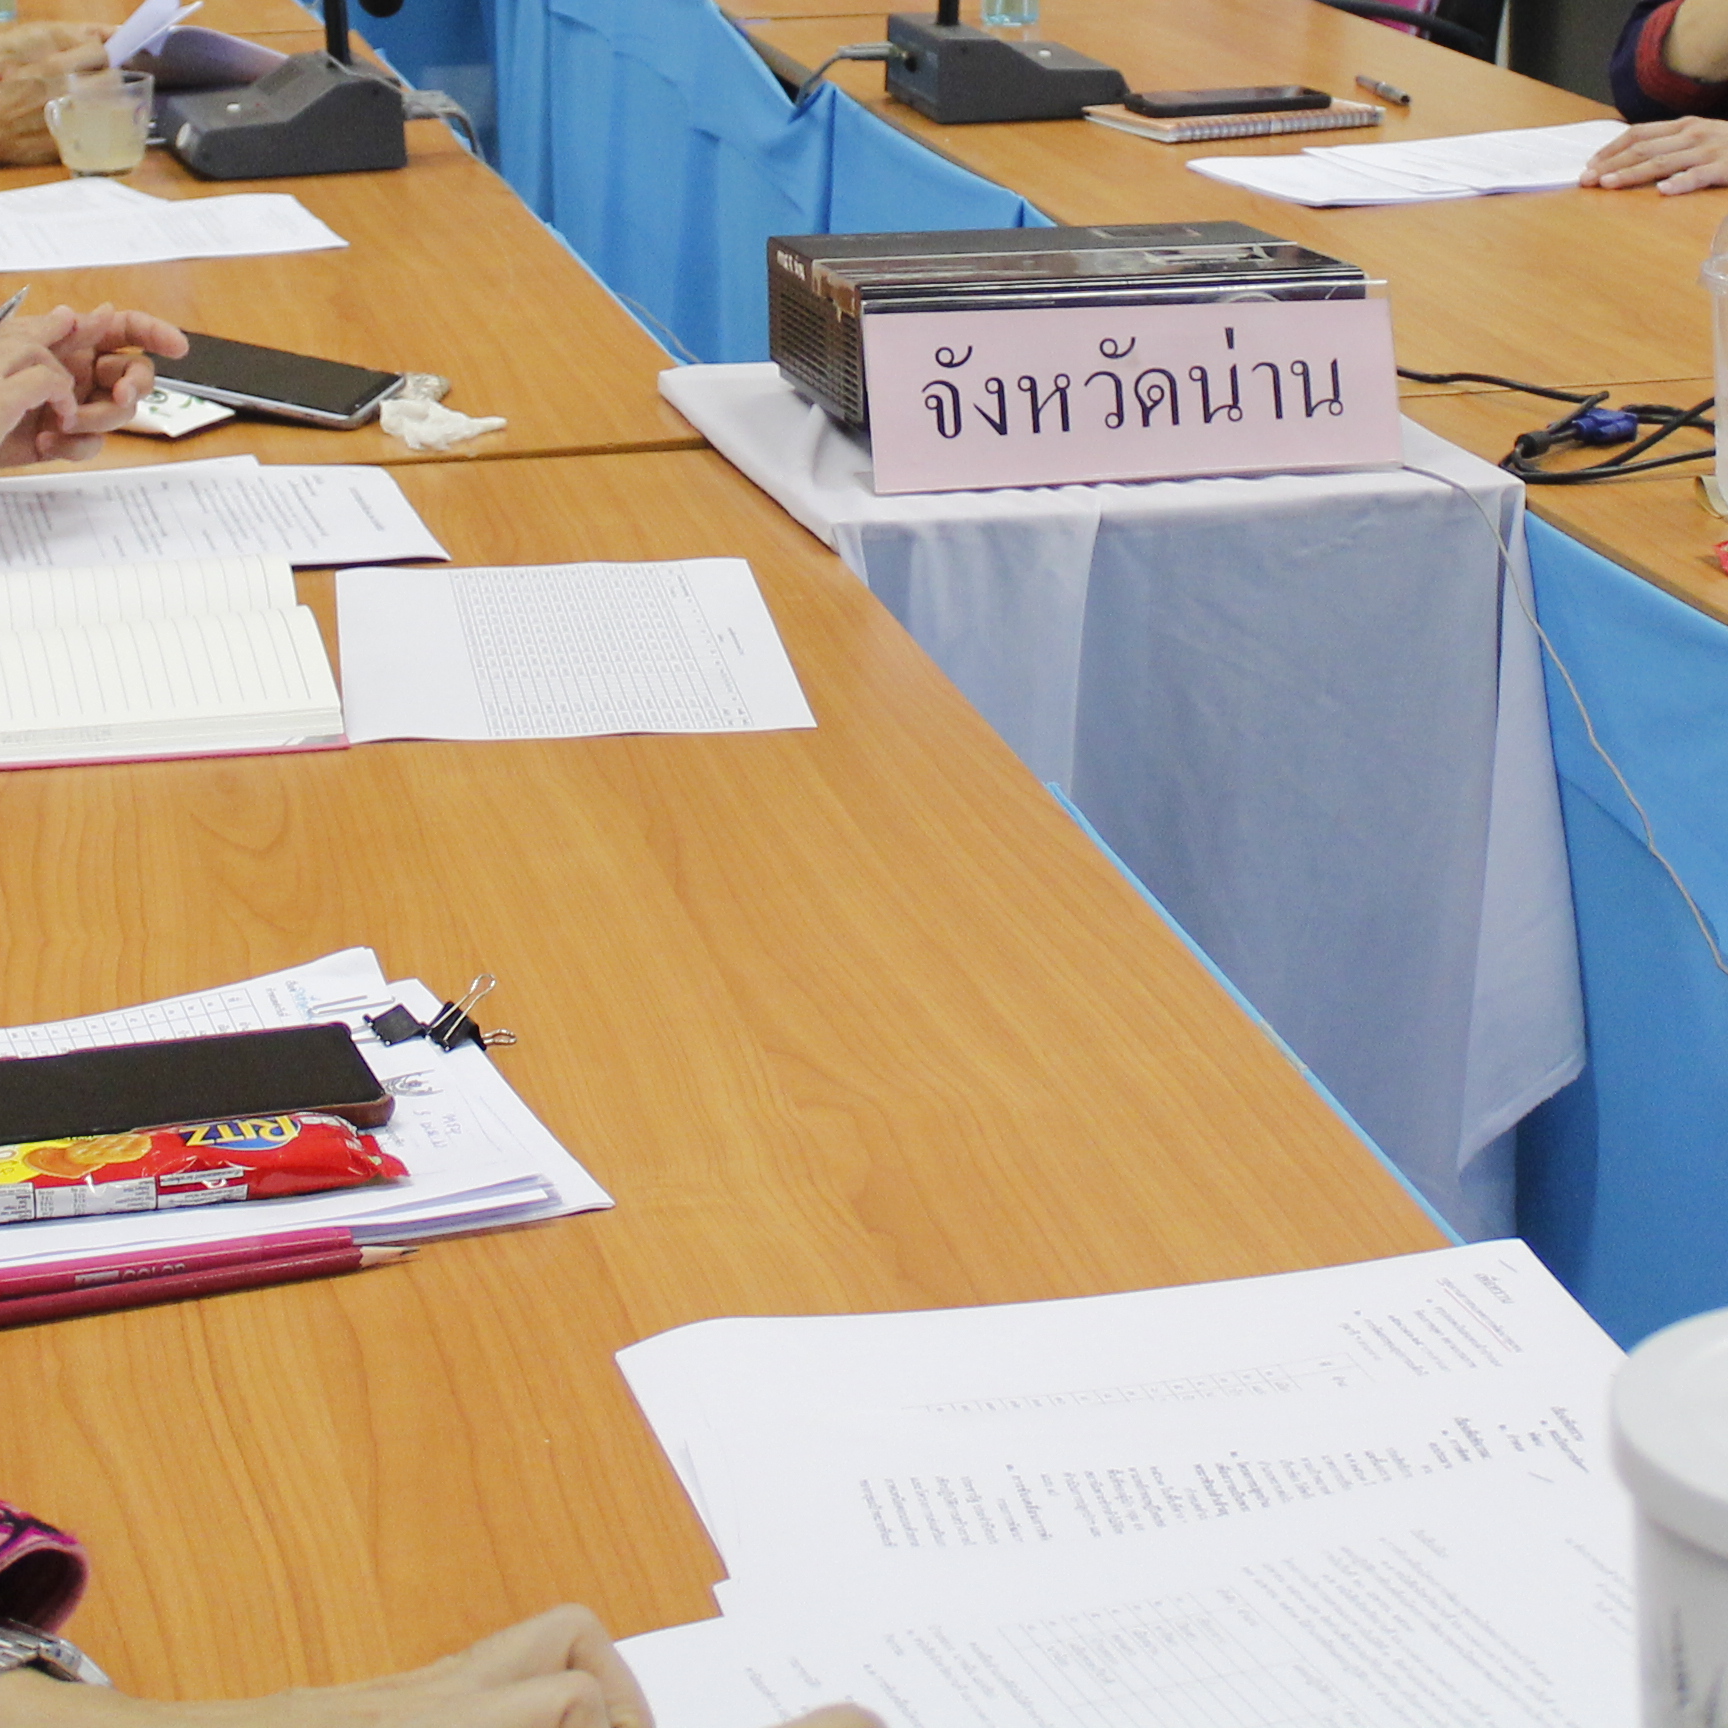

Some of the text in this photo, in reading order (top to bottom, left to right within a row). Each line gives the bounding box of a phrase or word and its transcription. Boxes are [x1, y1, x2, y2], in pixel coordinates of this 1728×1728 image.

[921, 327, 1345, 440] จังหวัดน่าน
[178, 1114, 298, 1147] RITZ
